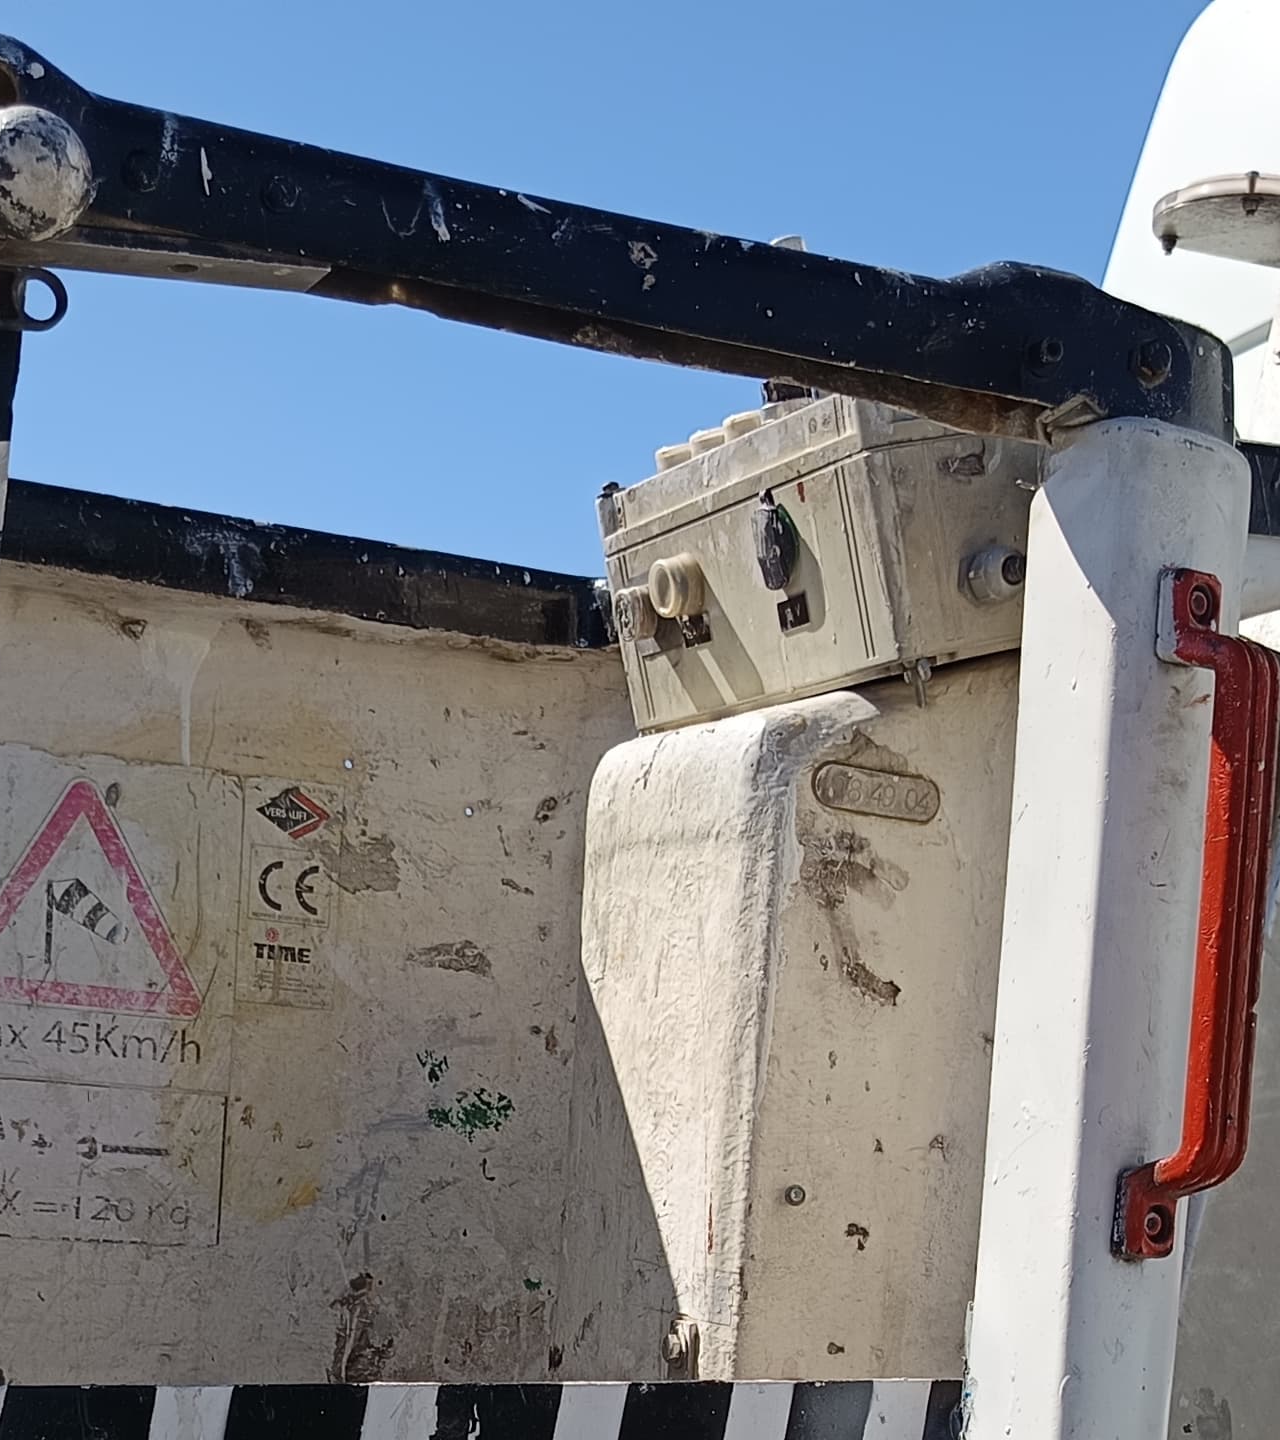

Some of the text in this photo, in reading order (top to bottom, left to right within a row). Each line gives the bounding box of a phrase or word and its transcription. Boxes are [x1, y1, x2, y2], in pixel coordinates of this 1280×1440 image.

[258, 860, 320, 916] CE
[254, 942, 311, 964] TIME
[41, 1017, 202, 1064] 45Km/h
[73, 1195, 135, 1223] 120
